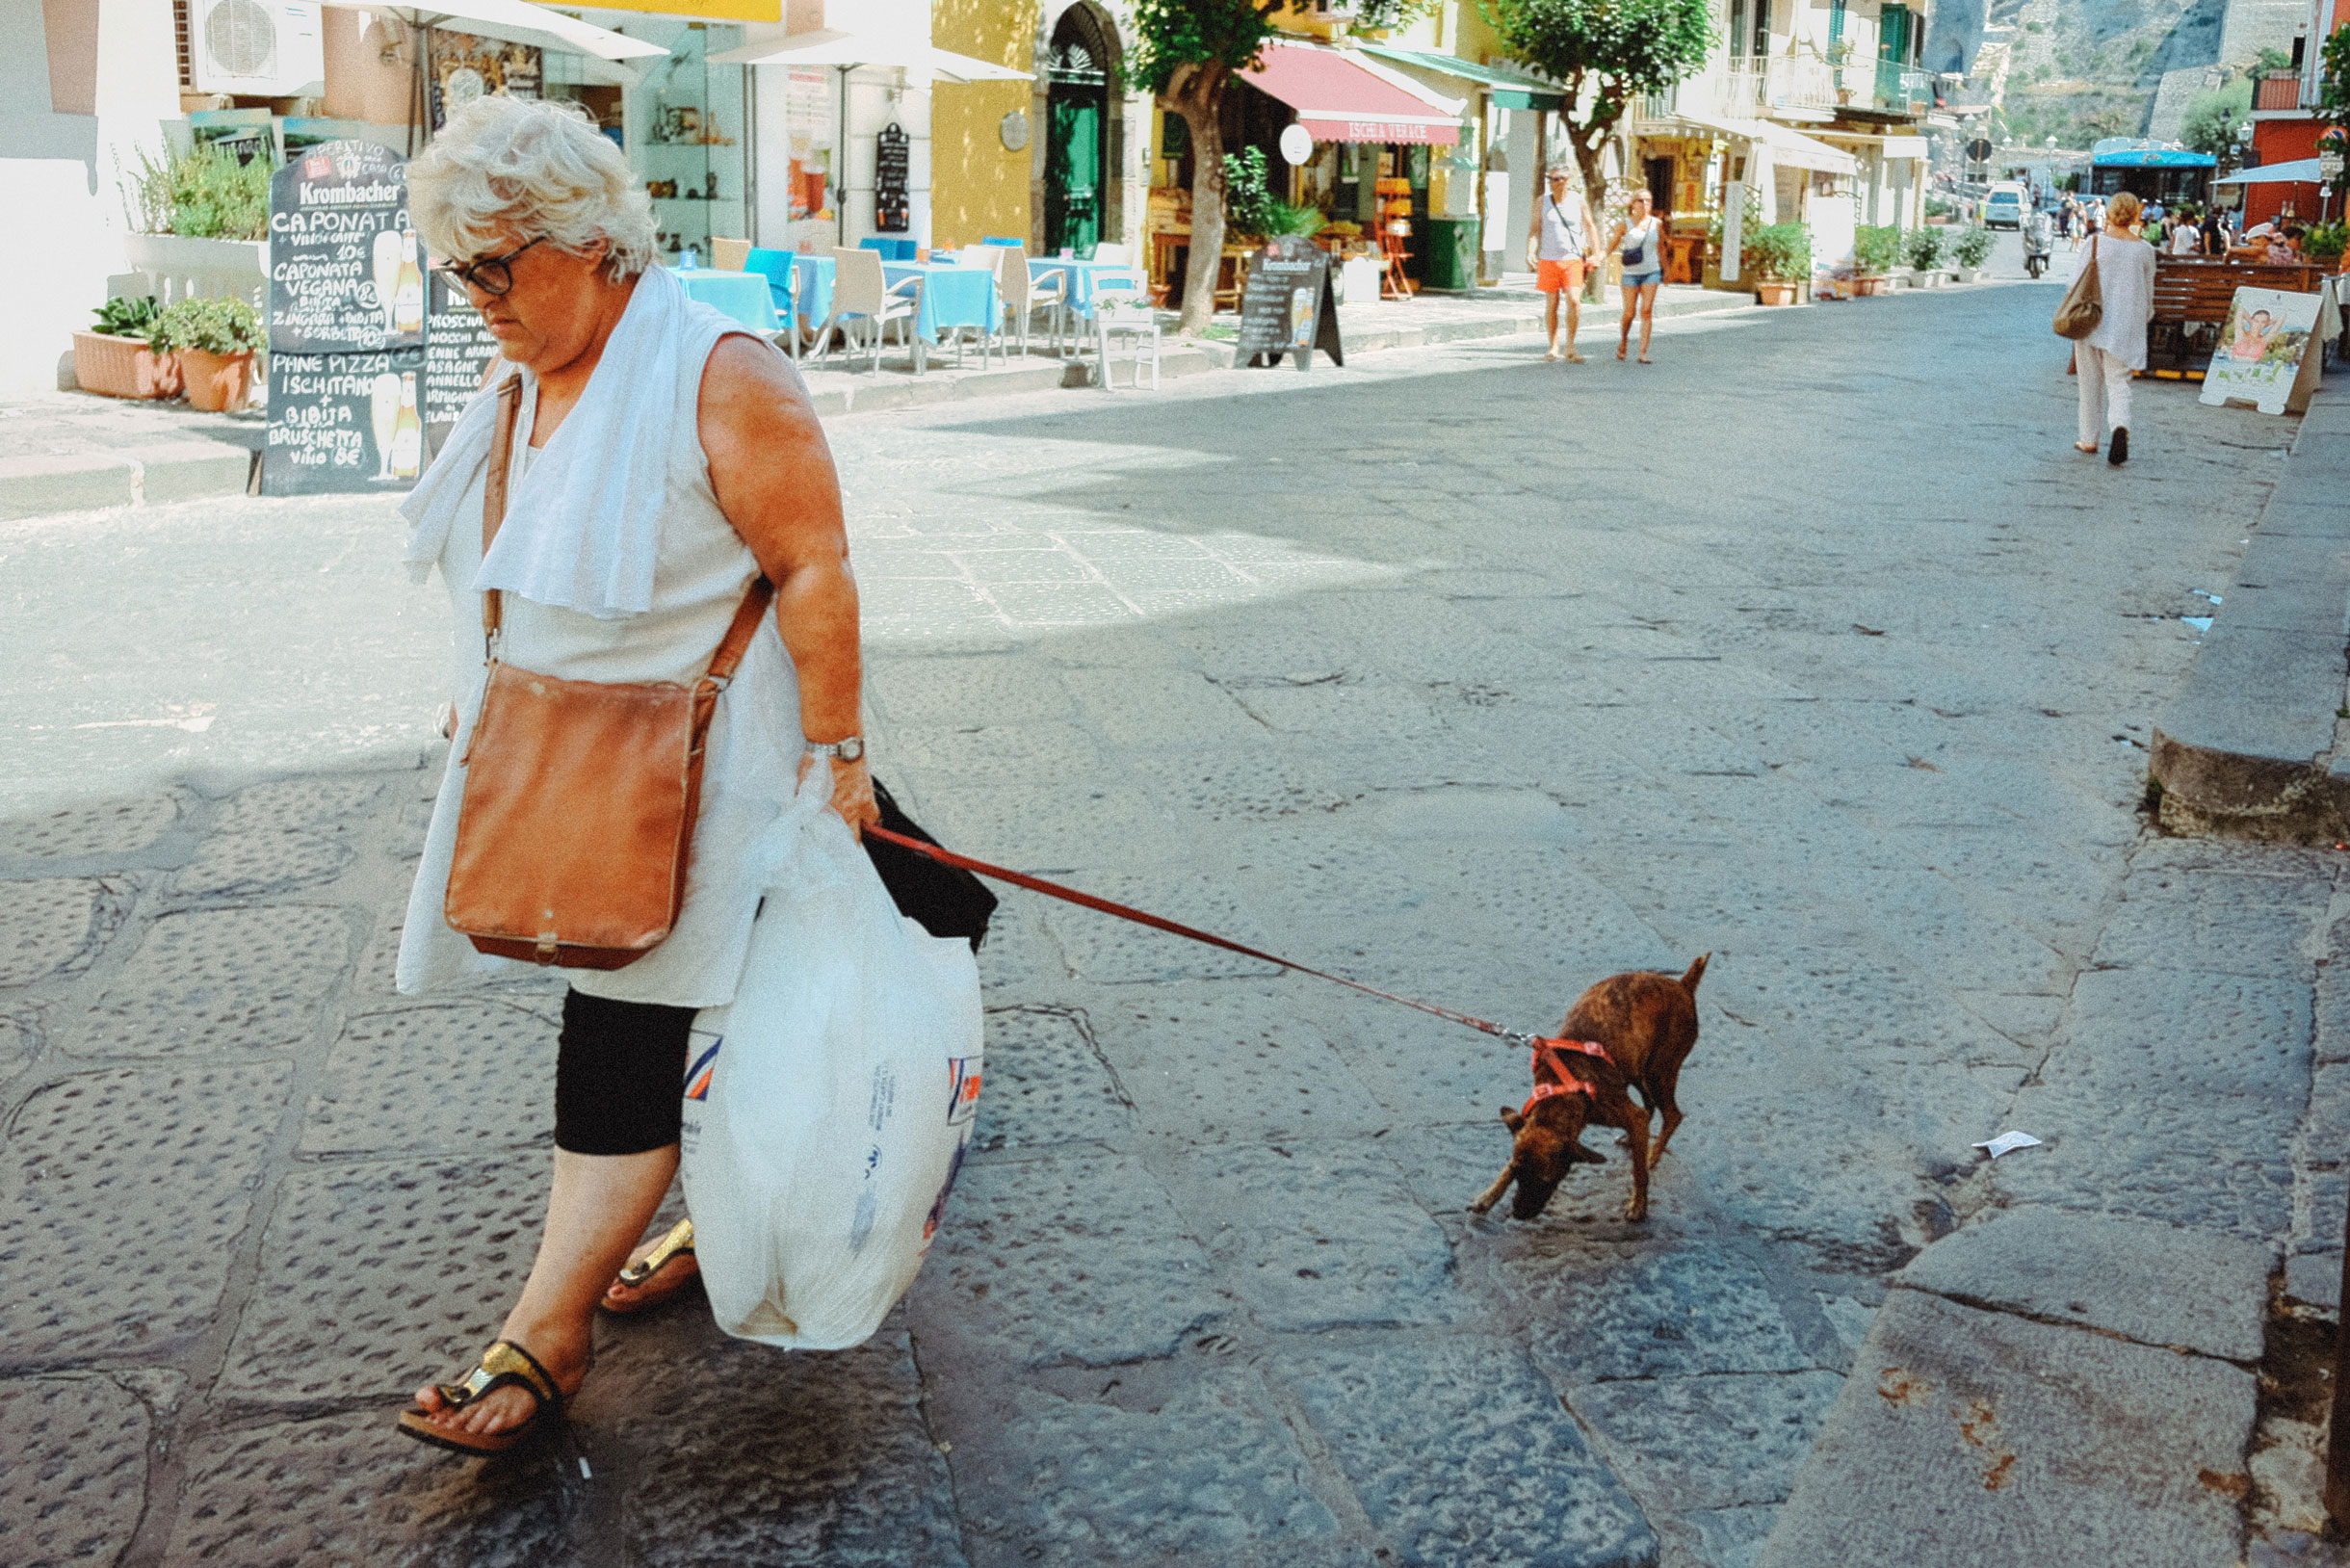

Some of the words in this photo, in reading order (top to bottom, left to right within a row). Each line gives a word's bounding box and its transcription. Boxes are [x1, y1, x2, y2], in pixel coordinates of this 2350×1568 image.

[1348, 121, 1386, 138] ISCHIA
[1388, 123, 1427, 140] VERACE
[300, 180, 401, 205] Krombacher
[271, 209, 411, 232] CAPONATA
[274, 261, 363, 281] CAPONATA
[285, 278, 358, 297] VEGANA
[272, 310, 335, 327] ZINGARA
[429, 331, 472, 345] NOCCHI
[428, 347, 460, 360] ENNE
[273, 353, 323, 374] PANE
[328, 353, 389, 374] PIZZA
[426, 360, 479, 375] ASAGNE
[282, 374, 376, 398] ISCHITANO
[269, 428, 362, 449] BRUSCHETTA
[290, 450, 326, 465] VINO
